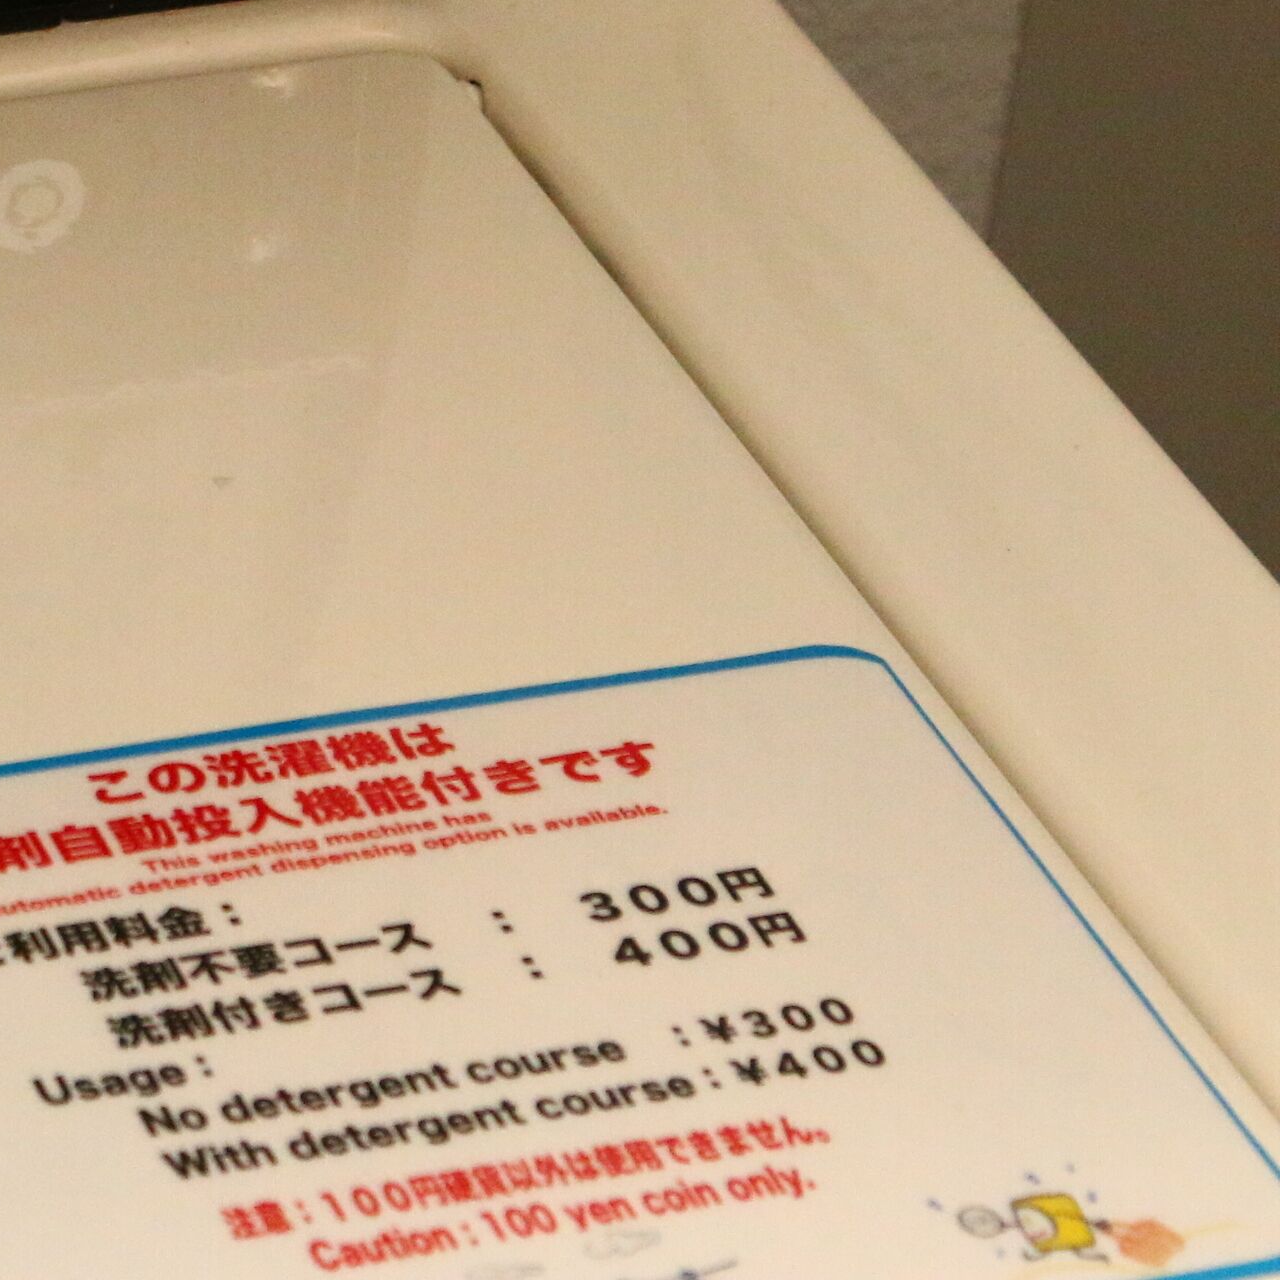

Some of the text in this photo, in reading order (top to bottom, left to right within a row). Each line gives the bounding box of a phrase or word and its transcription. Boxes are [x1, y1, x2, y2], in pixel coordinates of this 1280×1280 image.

[86, 722, 456, 806] この洗濯機は
[128, 863, 264, 897] detergent
[271, 837, 416, 874] dispensing
[424, 823, 508, 852] option
[512, 821, 537, 837] is
[545, 802, 669, 833] available.
[143, 809, 492, 875] This washing machine has
[80, 921, 433, 1003] 洗剤不要コース
[579, 866, 776, 923] 300円
[105, 968, 463, 1050] 洗剤付きコース
[614, 911, 808, 967] 400円
[137, 1105, 209, 1137] No
[221, 1060, 458, 1124] detergent
[466, 1038, 627, 1086] course
[162, 1136, 278, 1181] With
[287, 1097, 528, 1163] detergent
[481, 1204, 558, 1242] 100
[563, 1196, 637, 1232] yen
[642, 1178, 722, 1217] coin
[735, 1164, 817, 1202] only.
